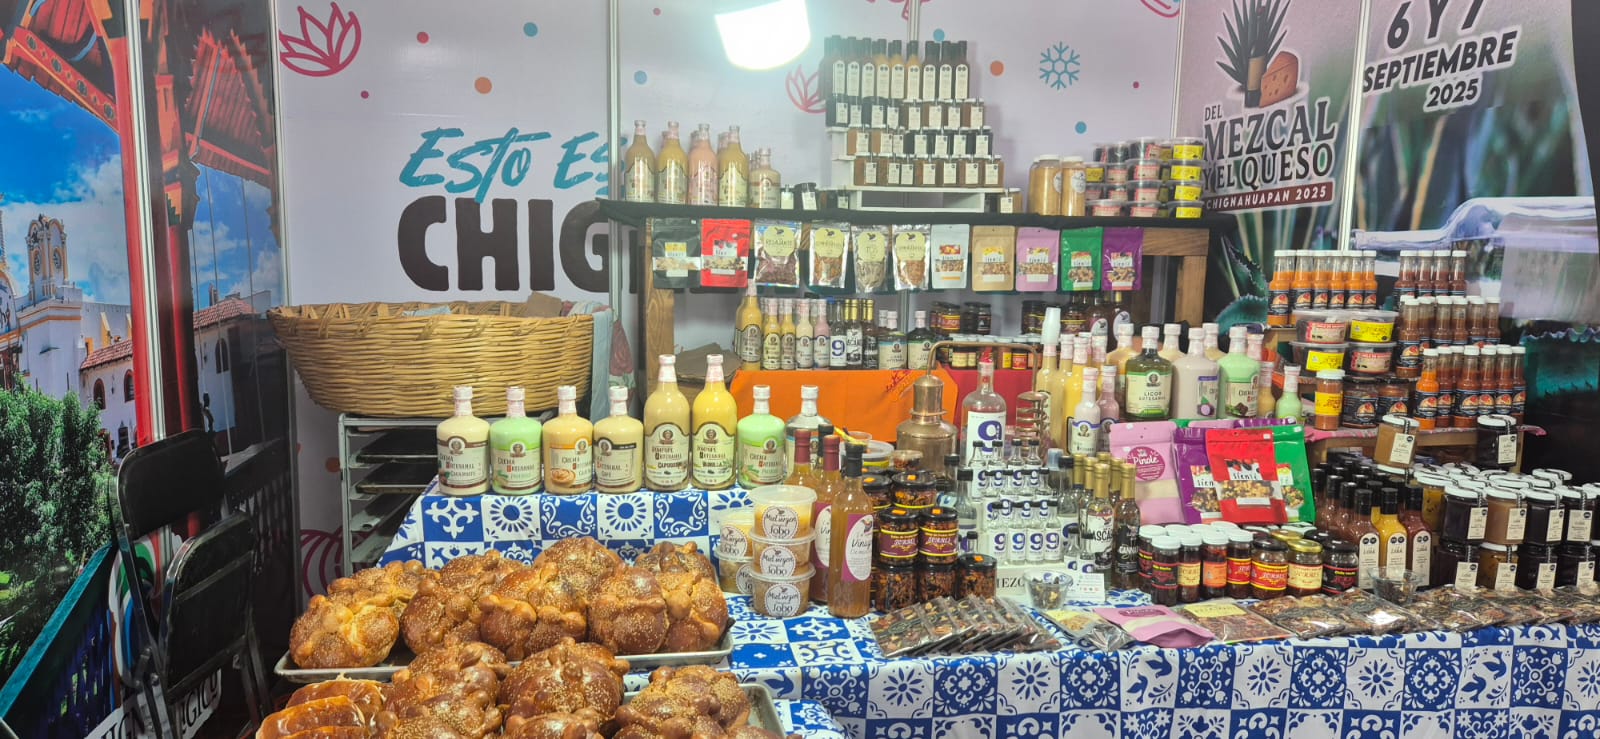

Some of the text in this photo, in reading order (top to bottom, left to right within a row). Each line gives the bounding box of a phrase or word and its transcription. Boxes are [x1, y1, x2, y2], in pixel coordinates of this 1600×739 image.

[1387, 1, 1410, 49] 6
[1363, 31, 1517, 92] SEPTIEMBRE
[1427, 79, 1478, 107] 2025
[1204, 106, 1222, 120] DEL
[1203, 101, 1336, 162] MEZCAL
[400, 127, 552, 203] Esto
[1203, 143, 1334, 190] Y EL QUESO
[1206, 185, 1327, 209] CHIGNAHUAPAN 2025
[831, 340, 845, 356] 9
[978, 420, 1002, 452] 9
[994, 533, 1006, 551] 9
[1012, 533, 1026, 551] 9
[1030, 533, 1044, 551] 9
[1045, 532, 1060, 550] 9
